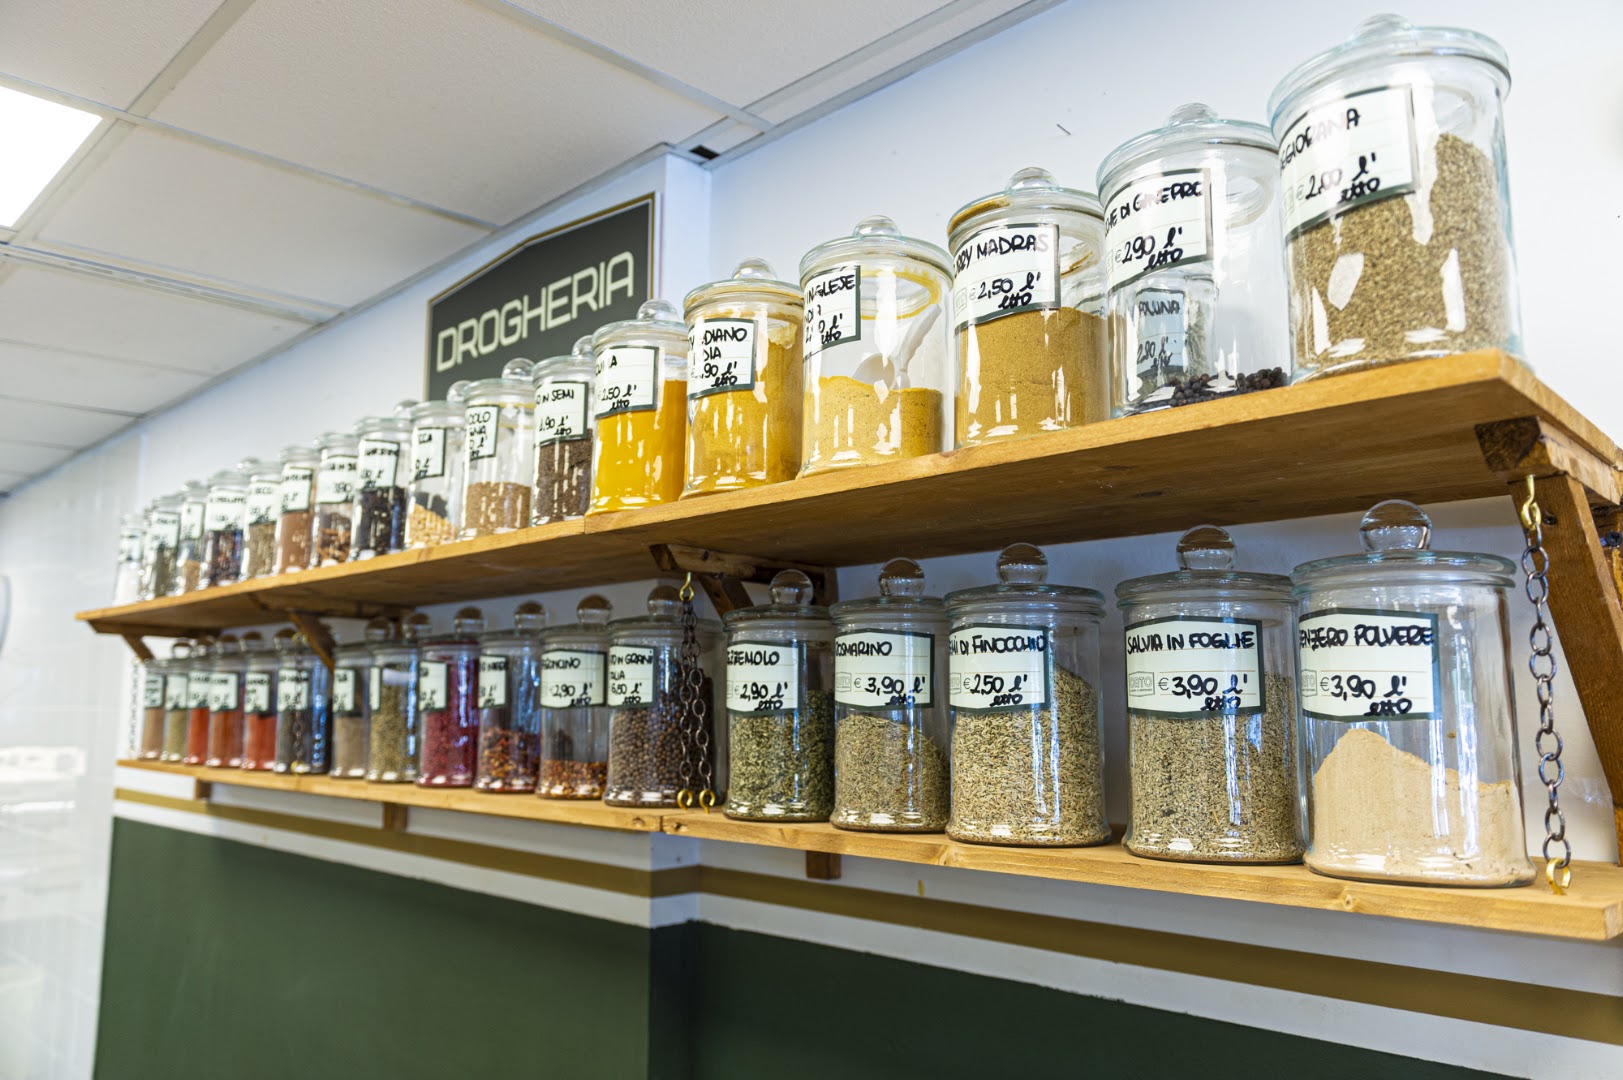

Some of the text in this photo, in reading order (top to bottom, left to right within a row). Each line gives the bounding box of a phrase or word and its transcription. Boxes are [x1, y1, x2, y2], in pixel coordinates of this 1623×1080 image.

[977, 233, 1049, 259] MADRAS
[1143, 247, 1184, 272] etto
[998, 292, 1032, 310] etto
[436, 251, 635, 373] DROGHERIA
[702, 326, 747, 345] DIANO
[551, 388, 575, 402] SEMI
[1127, 631, 1255, 654] SALVIA IN FOGLIE
[1354, 624, 1435, 647] POLVERE
[753, 698, 784, 712] etto
[989, 693, 1023, 707] etto
[1200, 695, 1241, 711] etto
[1363, 698, 1412, 716] etto
